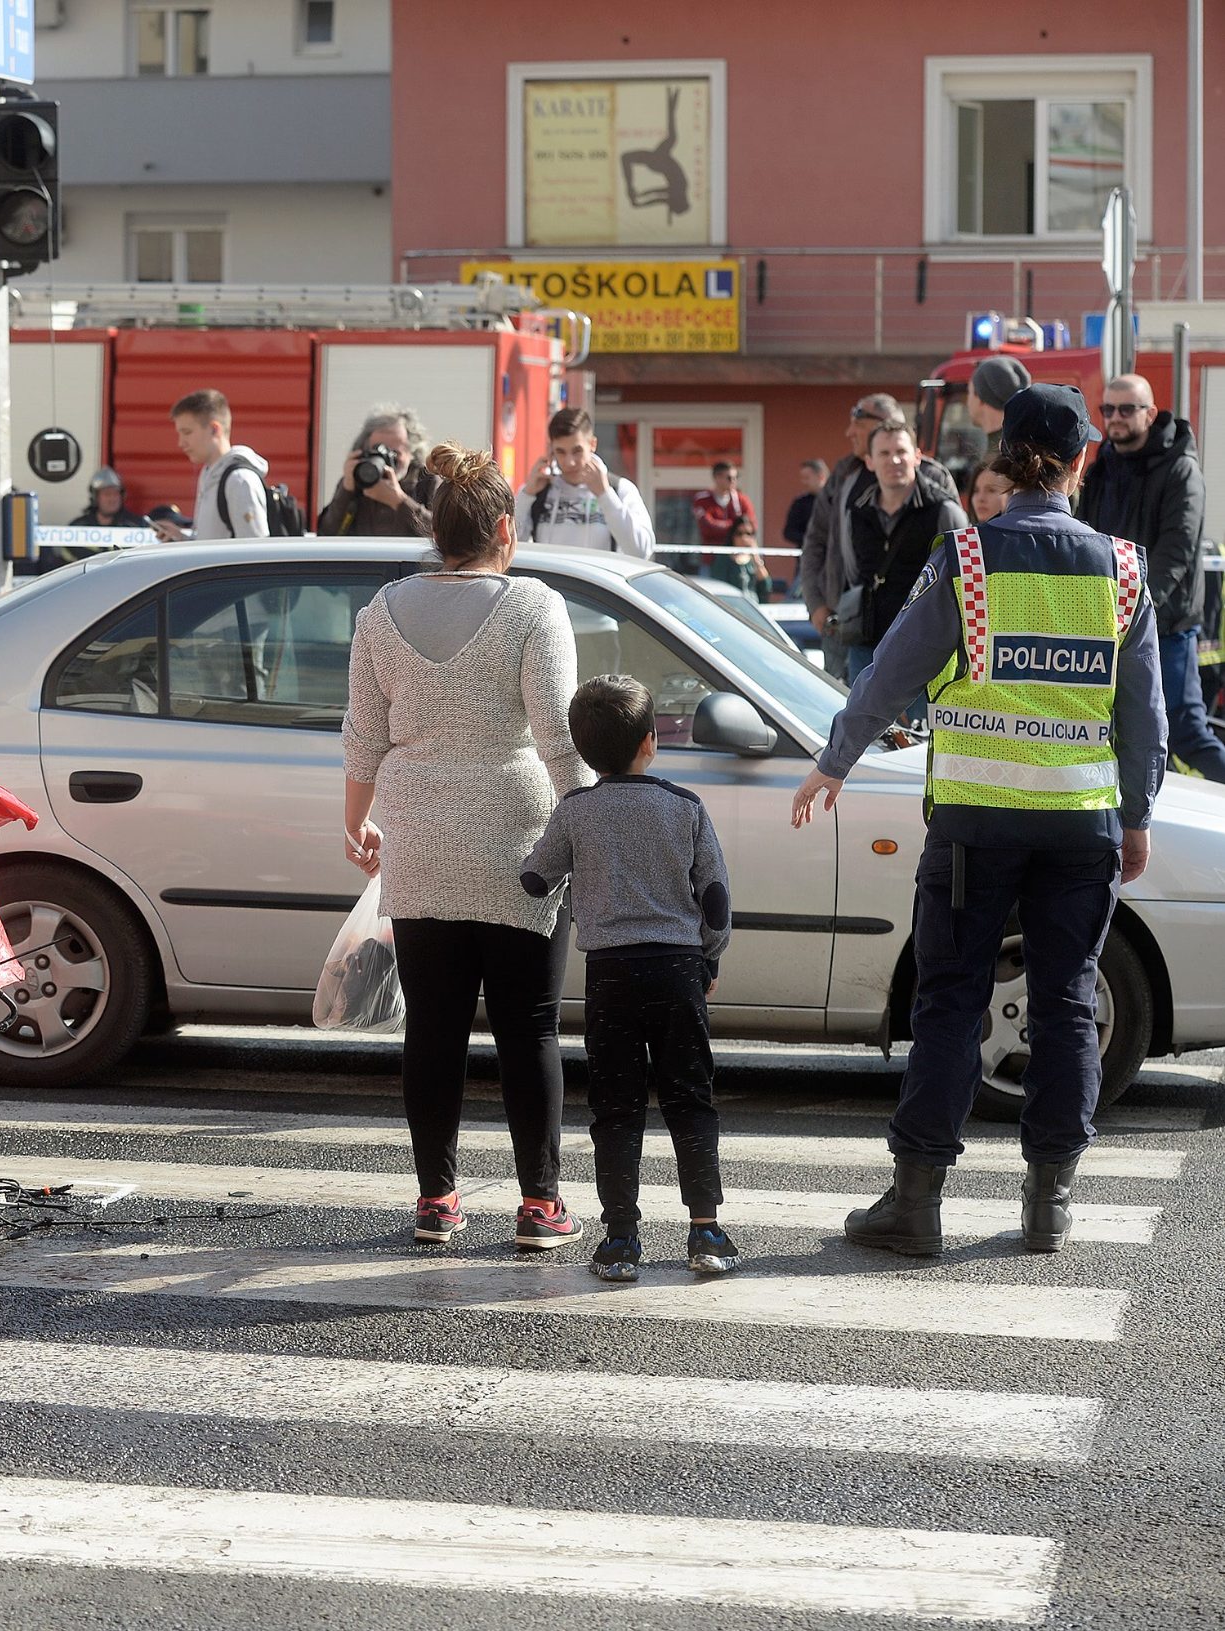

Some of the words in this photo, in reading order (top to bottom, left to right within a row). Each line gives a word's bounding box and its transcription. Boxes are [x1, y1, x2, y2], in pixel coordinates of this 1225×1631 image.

[533, 97, 608, 118] KARATE
[997, 646, 1107, 674] POLICIJA
[935, 709, 1006, 734] POLICIJA
[1014, 720, 1089, 741] POLICIJA
